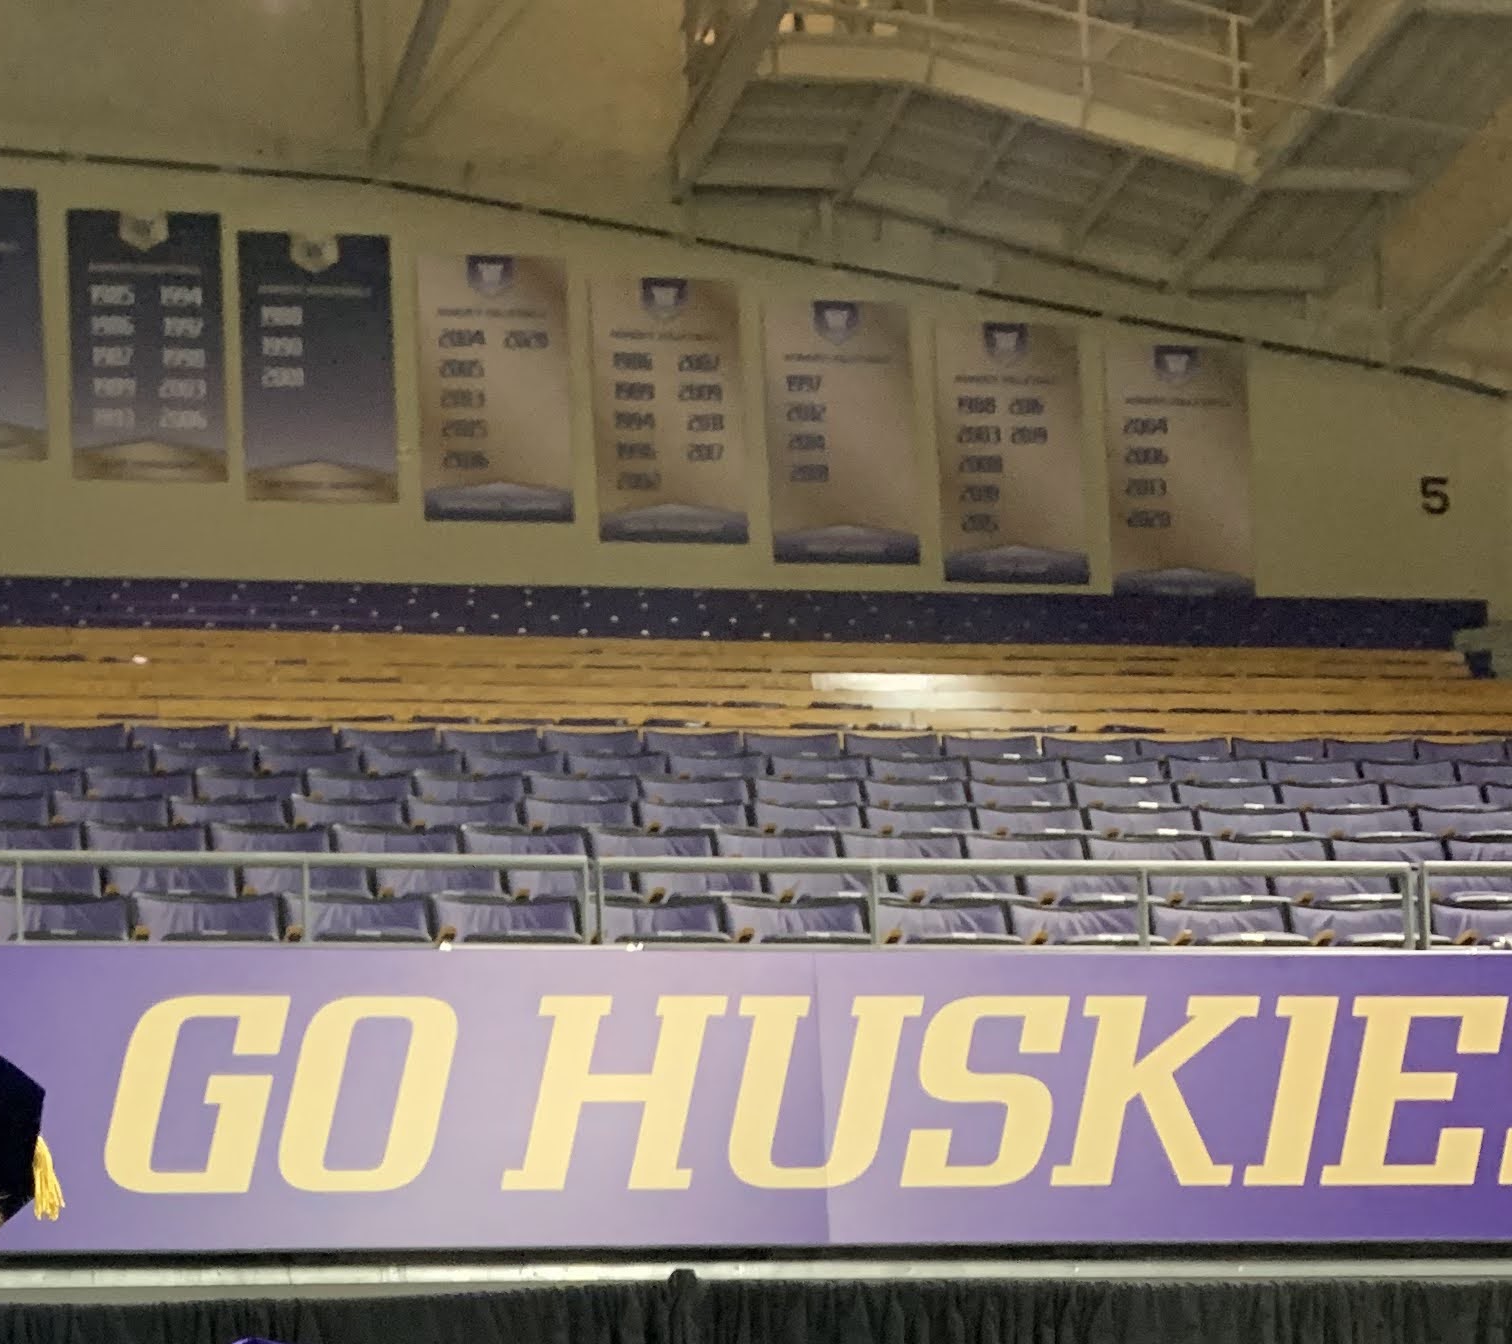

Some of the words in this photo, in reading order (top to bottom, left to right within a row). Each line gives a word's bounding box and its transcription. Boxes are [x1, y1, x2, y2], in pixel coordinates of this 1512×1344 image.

[1420, 476, 1451, 515] 5
[103, 995, 459, 1193] GO
[500, 995, 1512, 1192] HUSKIE
